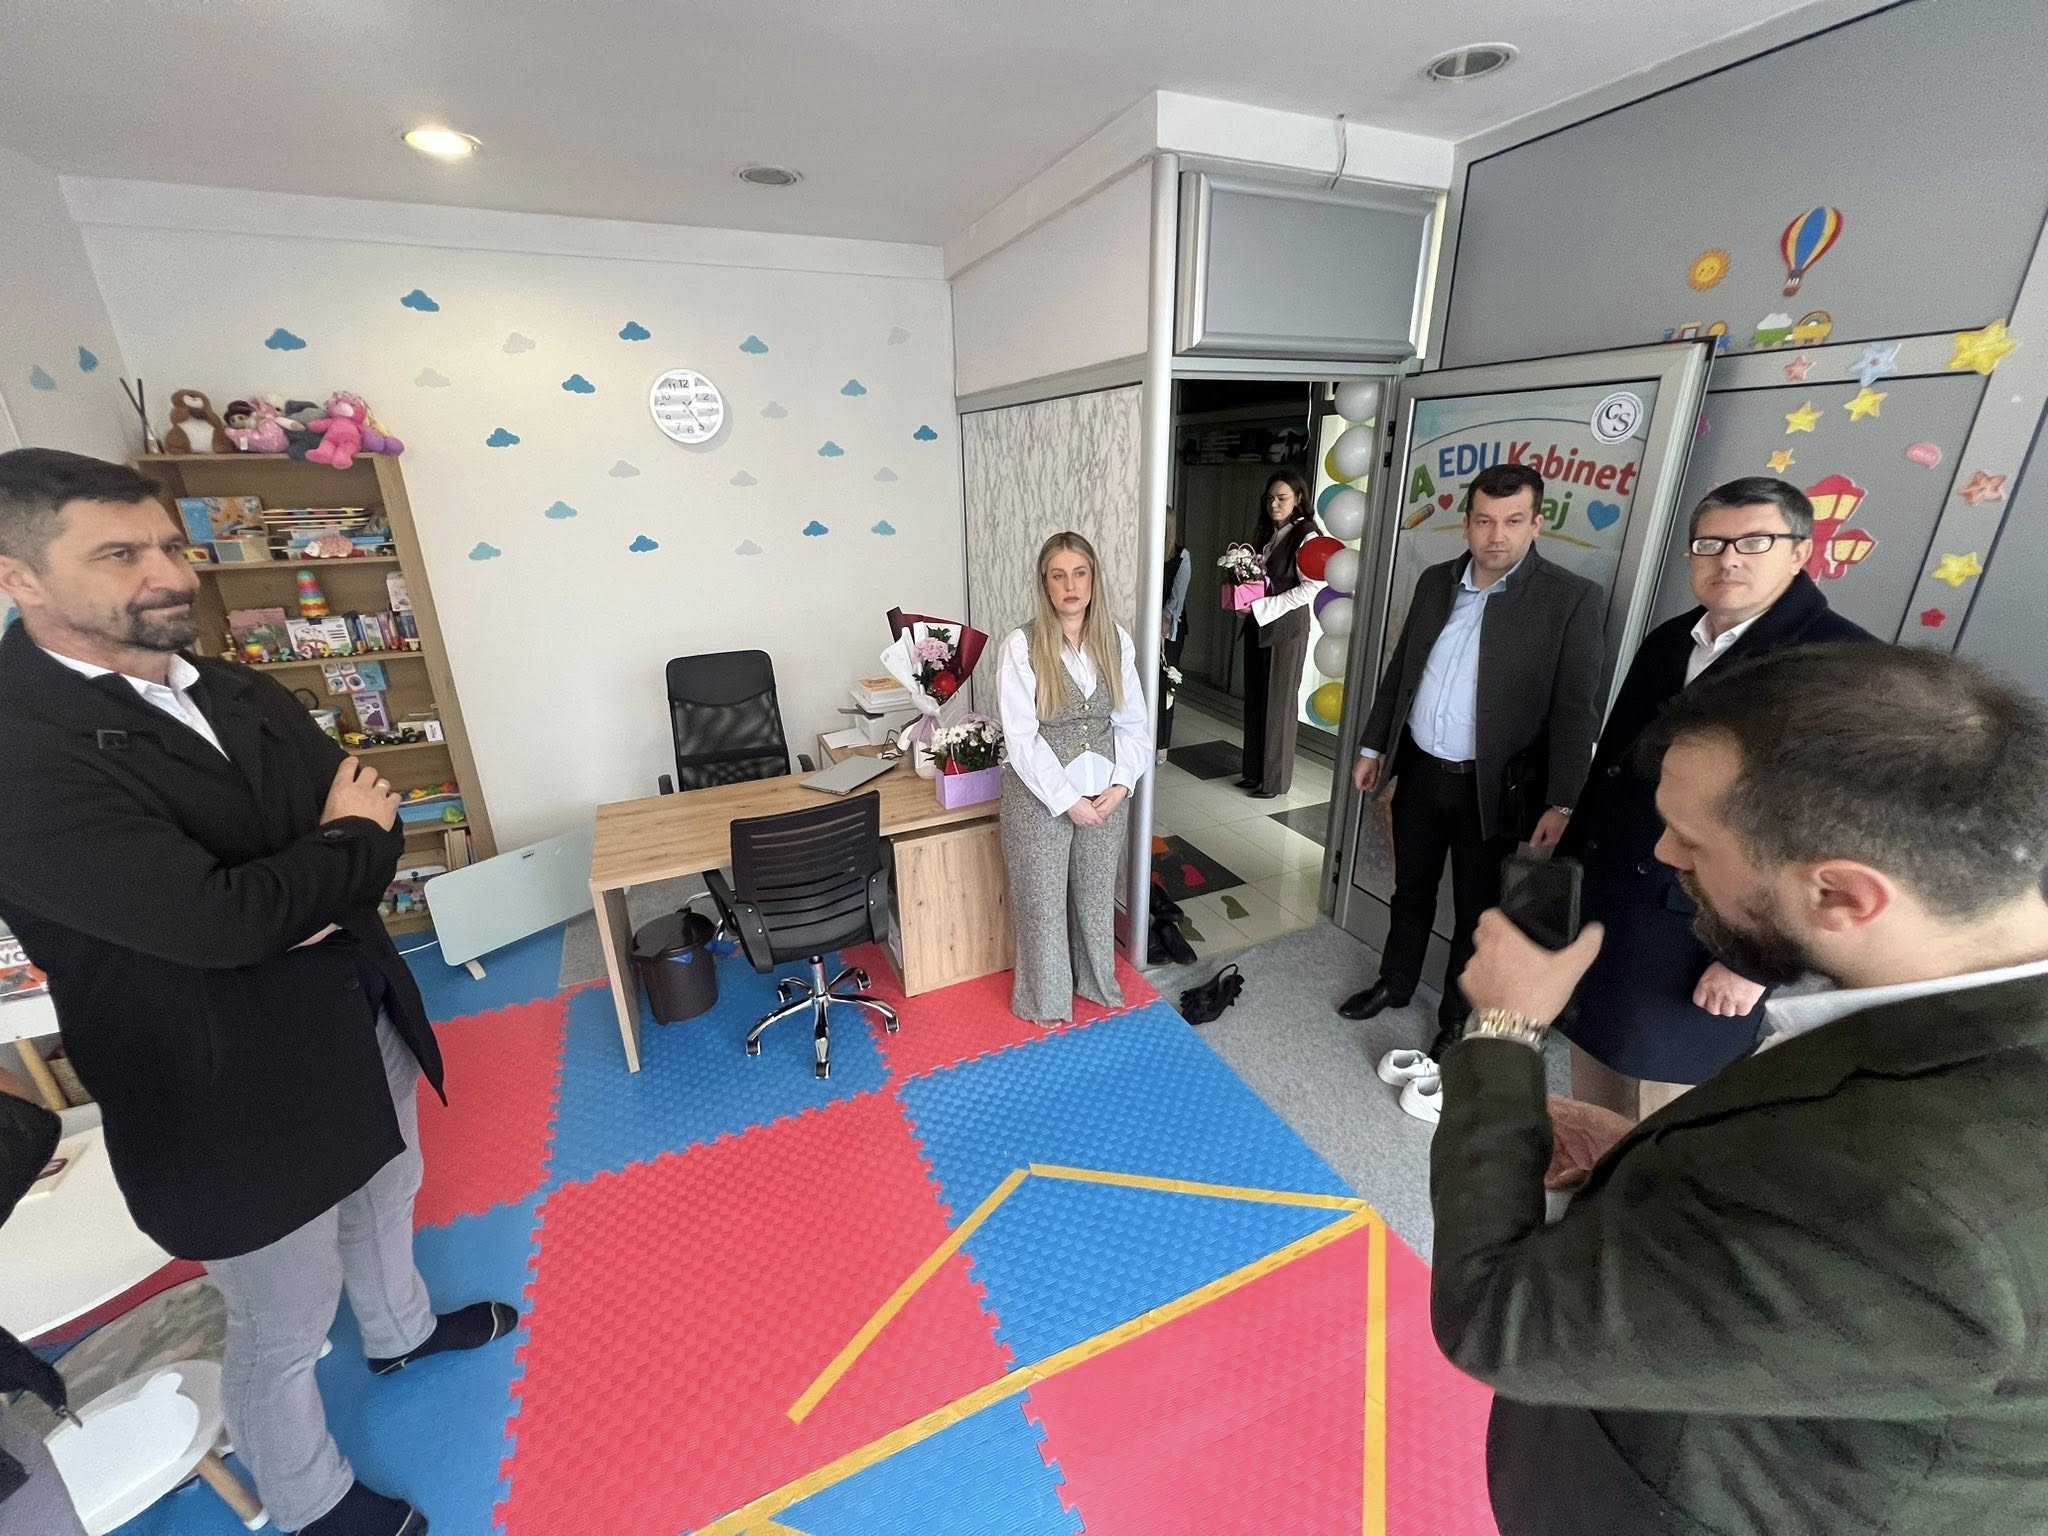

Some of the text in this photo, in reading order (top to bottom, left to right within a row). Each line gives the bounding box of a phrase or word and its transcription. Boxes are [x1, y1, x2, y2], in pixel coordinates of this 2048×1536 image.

[1409, 463, 1436, 504] A
[1438, 441, 1637, 497] EDU Kabinet
